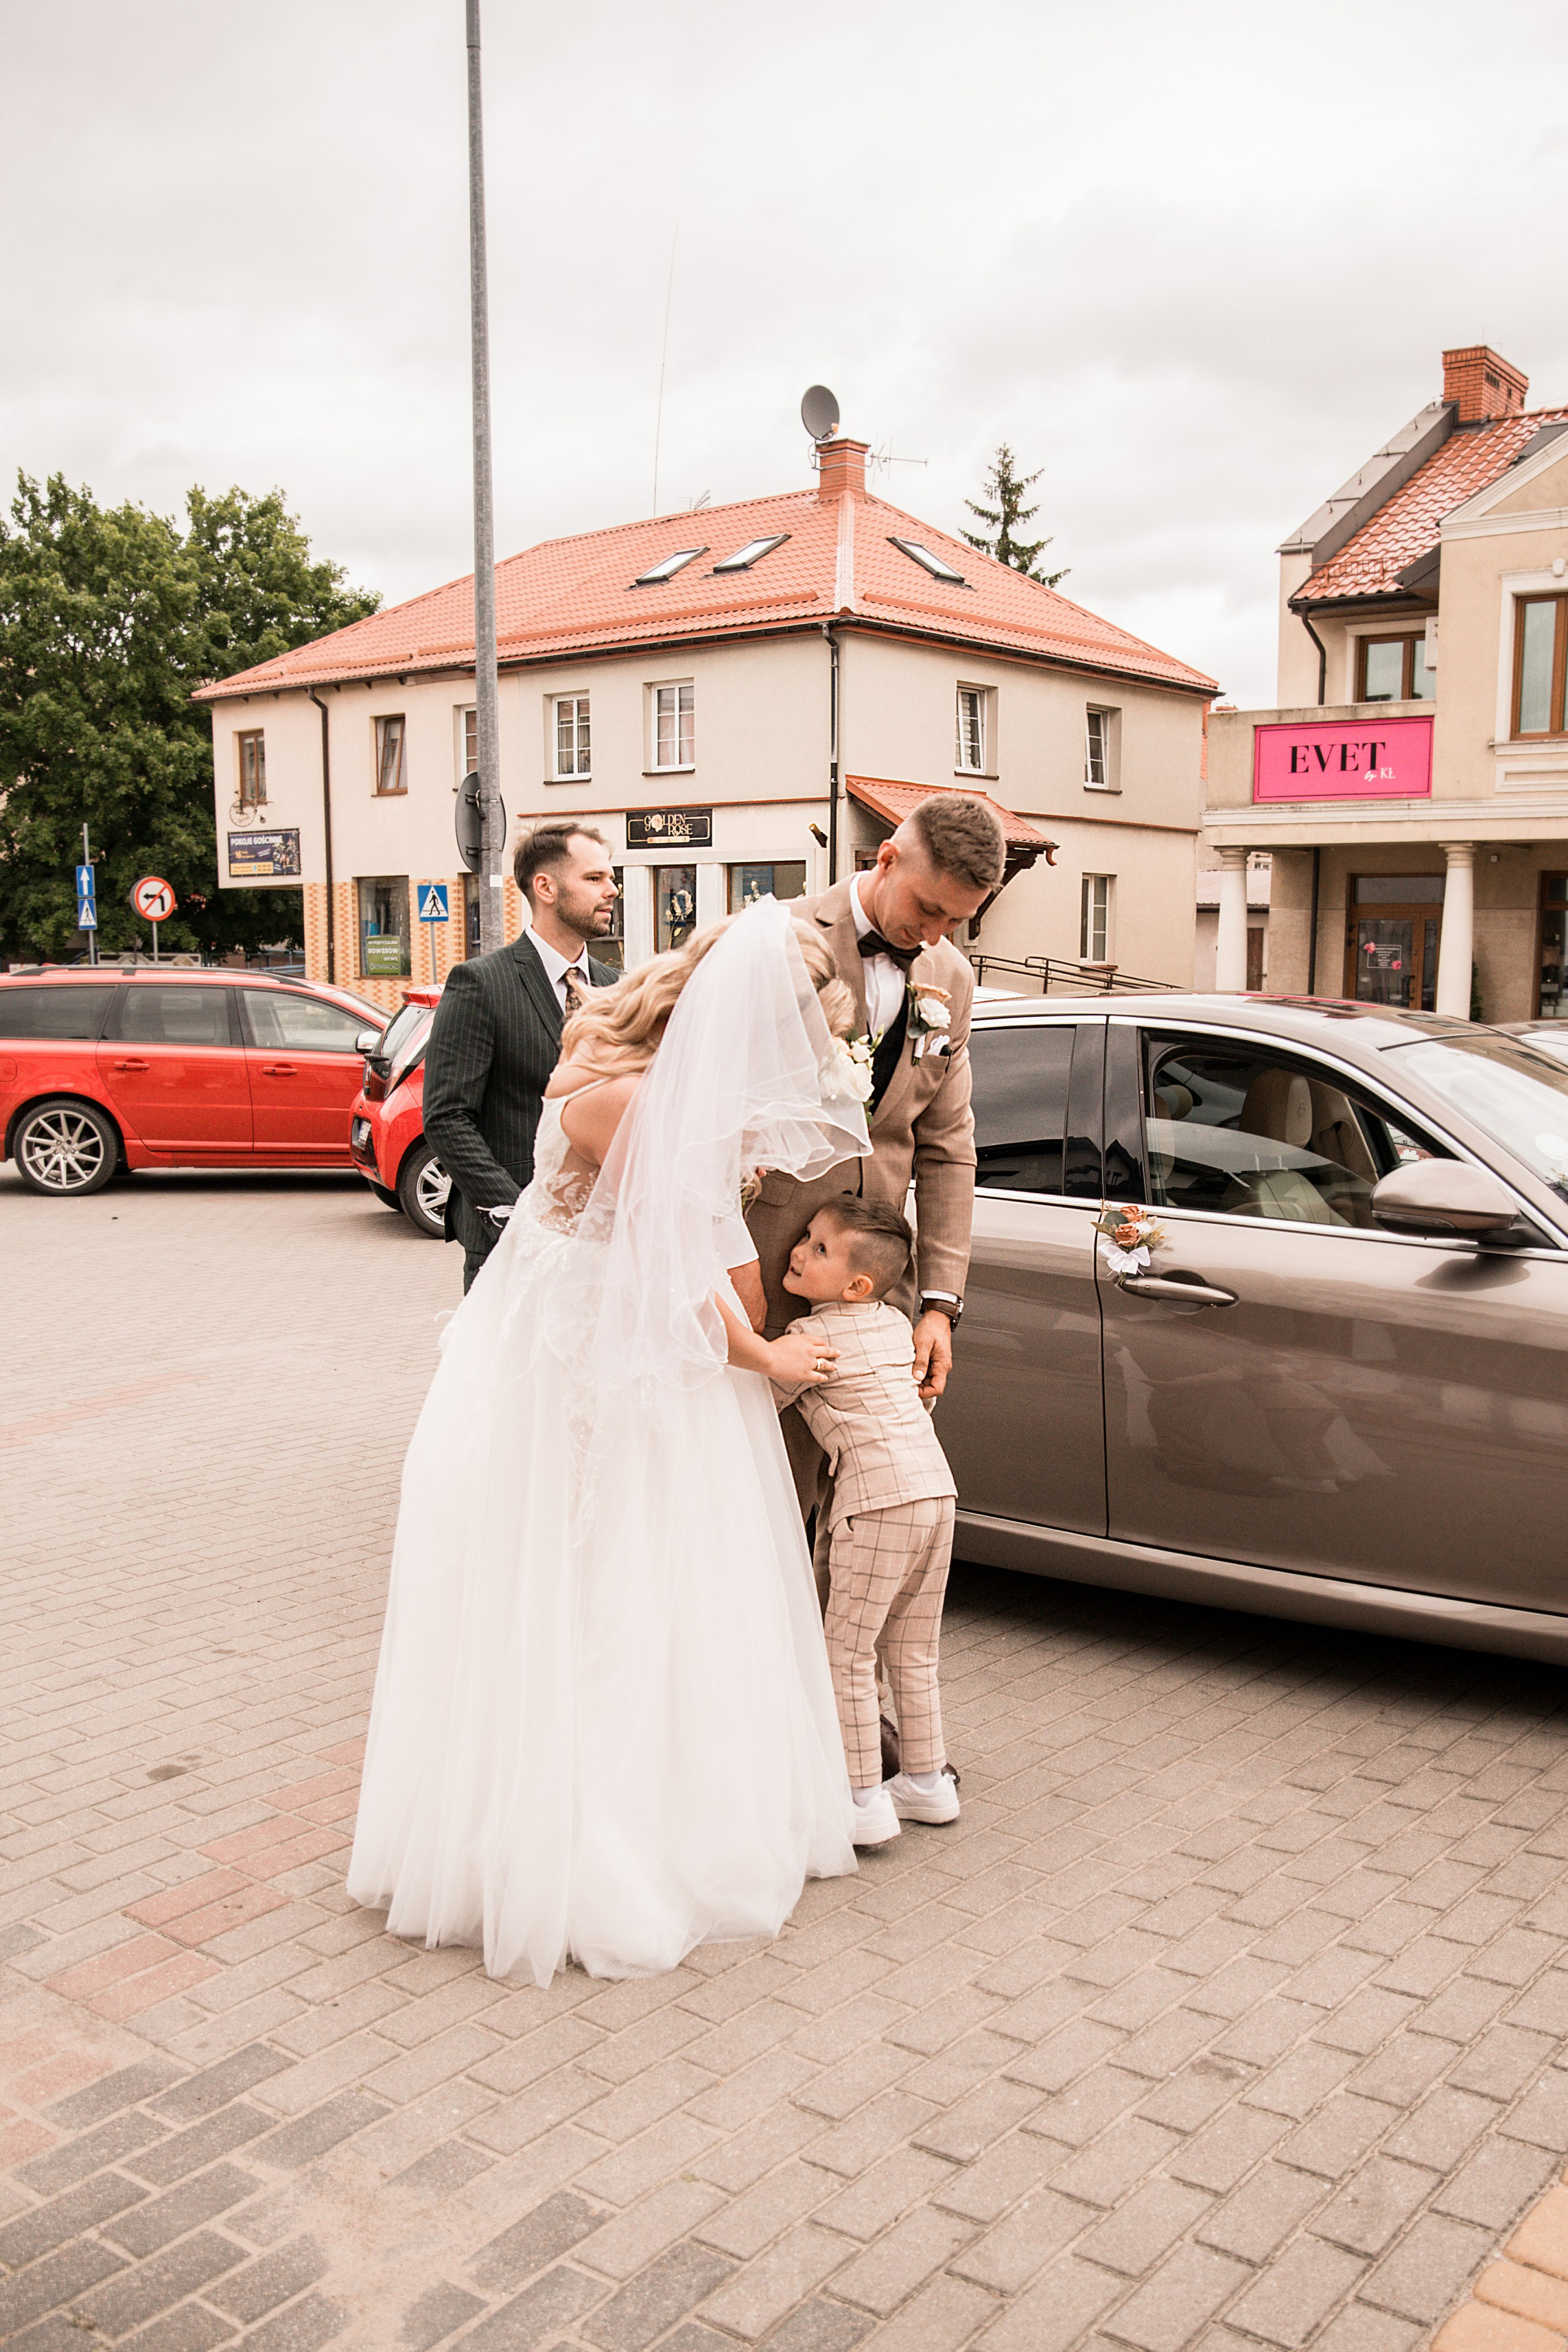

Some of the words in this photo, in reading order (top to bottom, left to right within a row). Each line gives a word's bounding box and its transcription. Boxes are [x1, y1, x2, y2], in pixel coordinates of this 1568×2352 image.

[1288, 742, 1385, 774] EVET
[1364, 770, 1378, 782] by
[1380, 767, 1396, 779] KŁ
[668, 823, 693, 837] ROSE
[230, 837, 253, 846] POKOJE
[253, 834, 283, 845] GOŚCINNE
